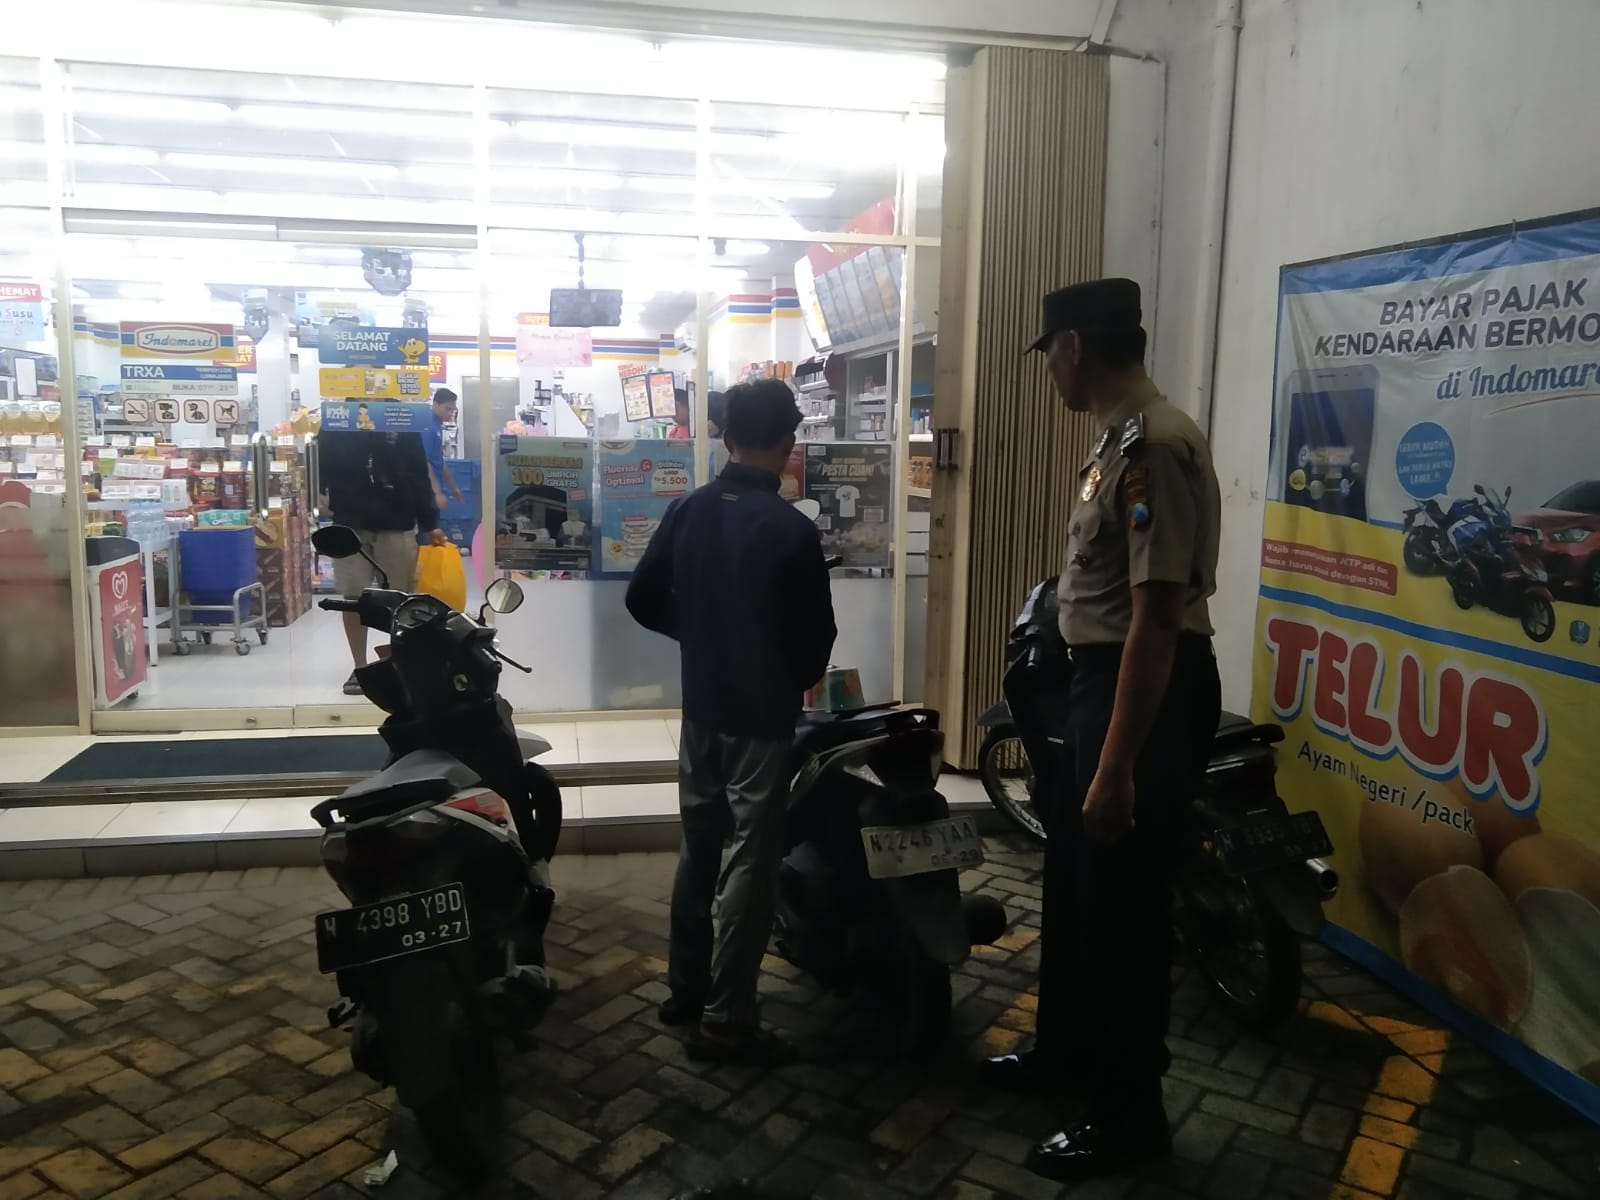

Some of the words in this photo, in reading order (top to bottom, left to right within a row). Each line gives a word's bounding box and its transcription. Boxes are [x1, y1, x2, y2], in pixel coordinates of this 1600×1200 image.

[1380, 292, 1472, 326] BAYAR
[1482, 278, 1588, 316] PAJAK
[142, 332, 213, 347] Indomaret
[334, 331, 391, 341] SELAMAT
[1314, 323, 1477, 357] KENDARAAN
[1485, 312, 1600, 348] BERMO
[336, 342, 388, 351] DATANG
[123, 366, 165, 378] TRXA
[1436, 370, 1462, 400] di
[603, 463, 639, 474] Fluoride
[512, 468, 544, 486] 100
[546, 479, 578, 488] GRATIS
[606, 475, 644, 487] Optimal
[1265, 543, 1289, 554] Wajib
[1330, 571, 1367, 584] dengan
[1266, 616, 1543, 809] TELUR
[1298, 741, 1347, 777] Ayam
[1350, 760, 1408, 806] Negeri
[1411, 790, 1475, 835] /pack
[357, 903, 410, 933] 4398
[421, 889, 462, 920] YBD
